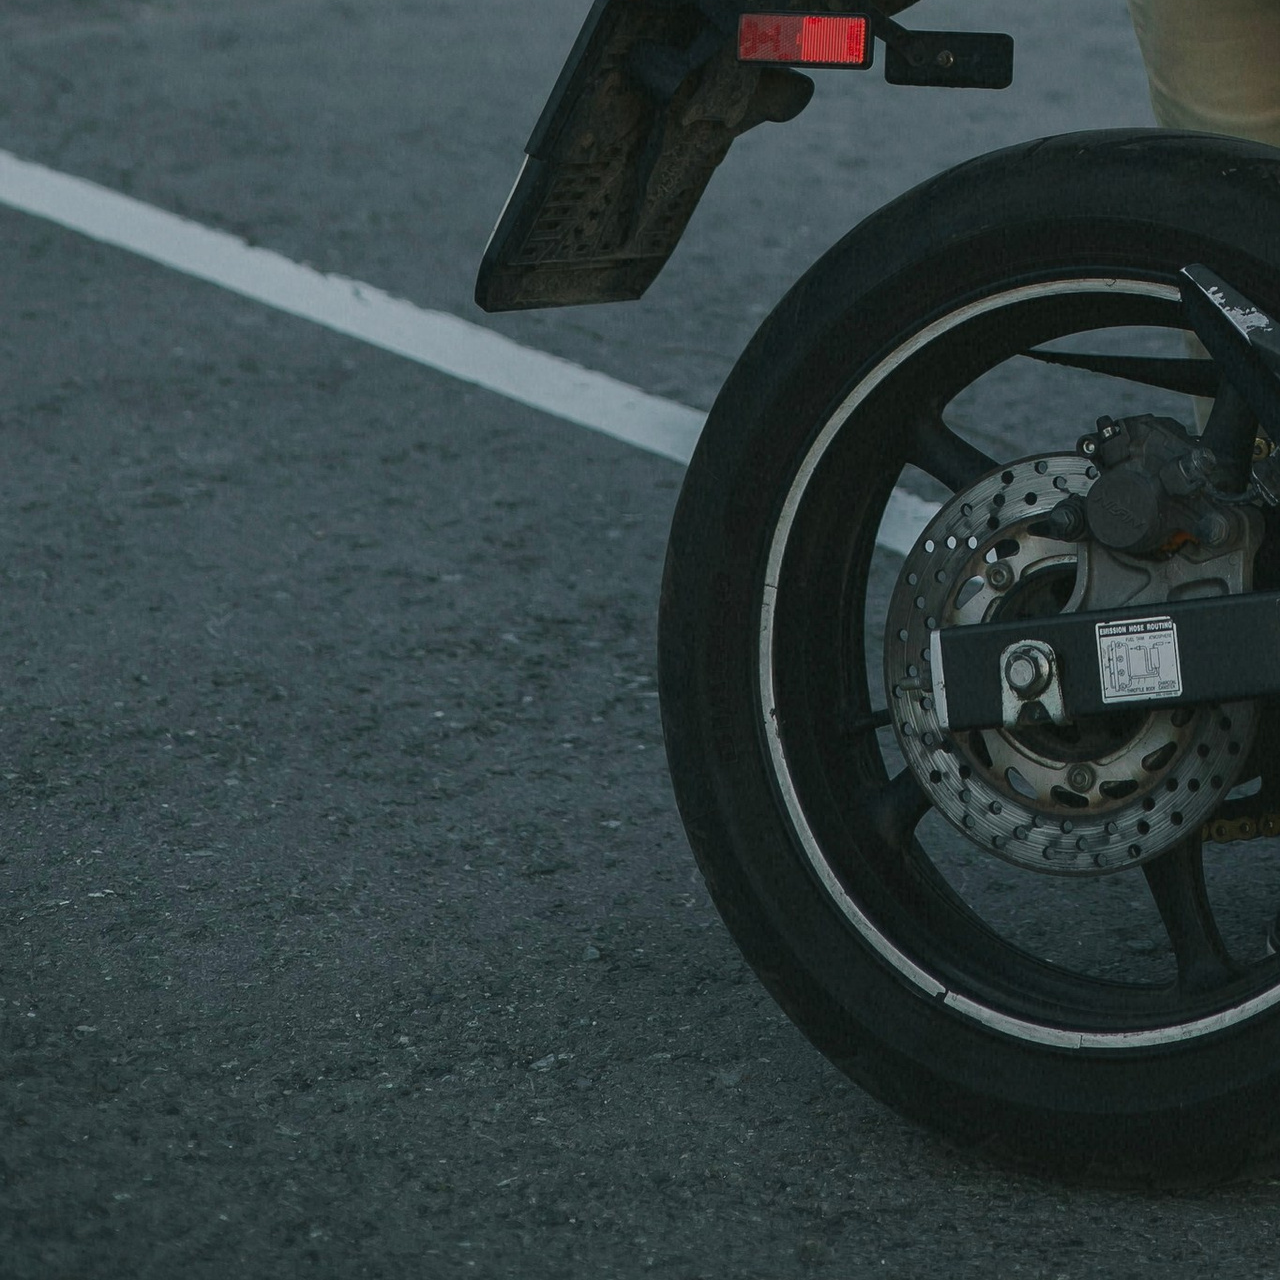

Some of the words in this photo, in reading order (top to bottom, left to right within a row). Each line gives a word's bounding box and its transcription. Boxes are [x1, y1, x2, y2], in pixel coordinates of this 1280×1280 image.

[1099, 626, 1127, 636] EMISSION
[1128, 623, 1145, 633] HOSE
[1146, 621, 1173, 631] ROUTING
